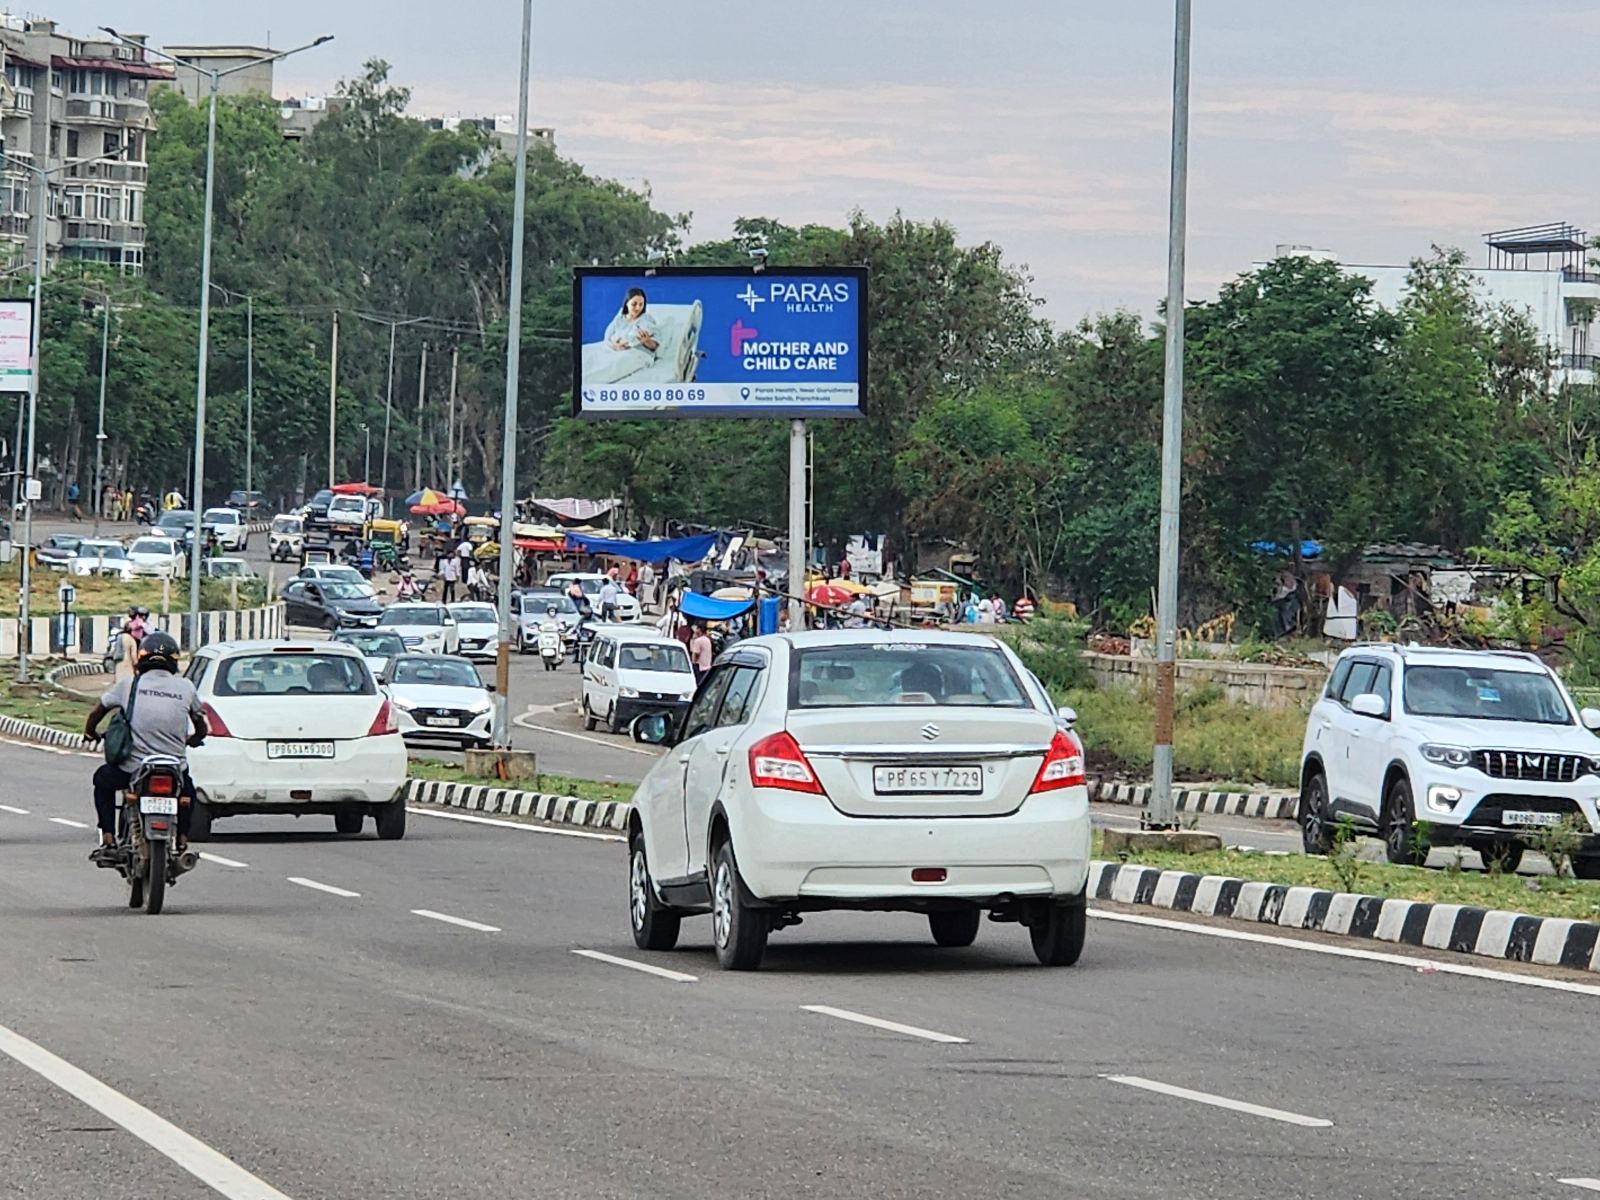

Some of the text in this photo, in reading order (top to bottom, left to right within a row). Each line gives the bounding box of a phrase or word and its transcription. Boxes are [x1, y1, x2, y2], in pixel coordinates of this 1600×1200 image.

[770, 283, 849, 302] PARAS
[787, 303, 834, 312] HEALTH
[743, 342, 849, 355] MOTHER AND
[743, 357, 837, 370] CHILD CARE
[600, 389, 705, 401] 80 80 80 80 69
